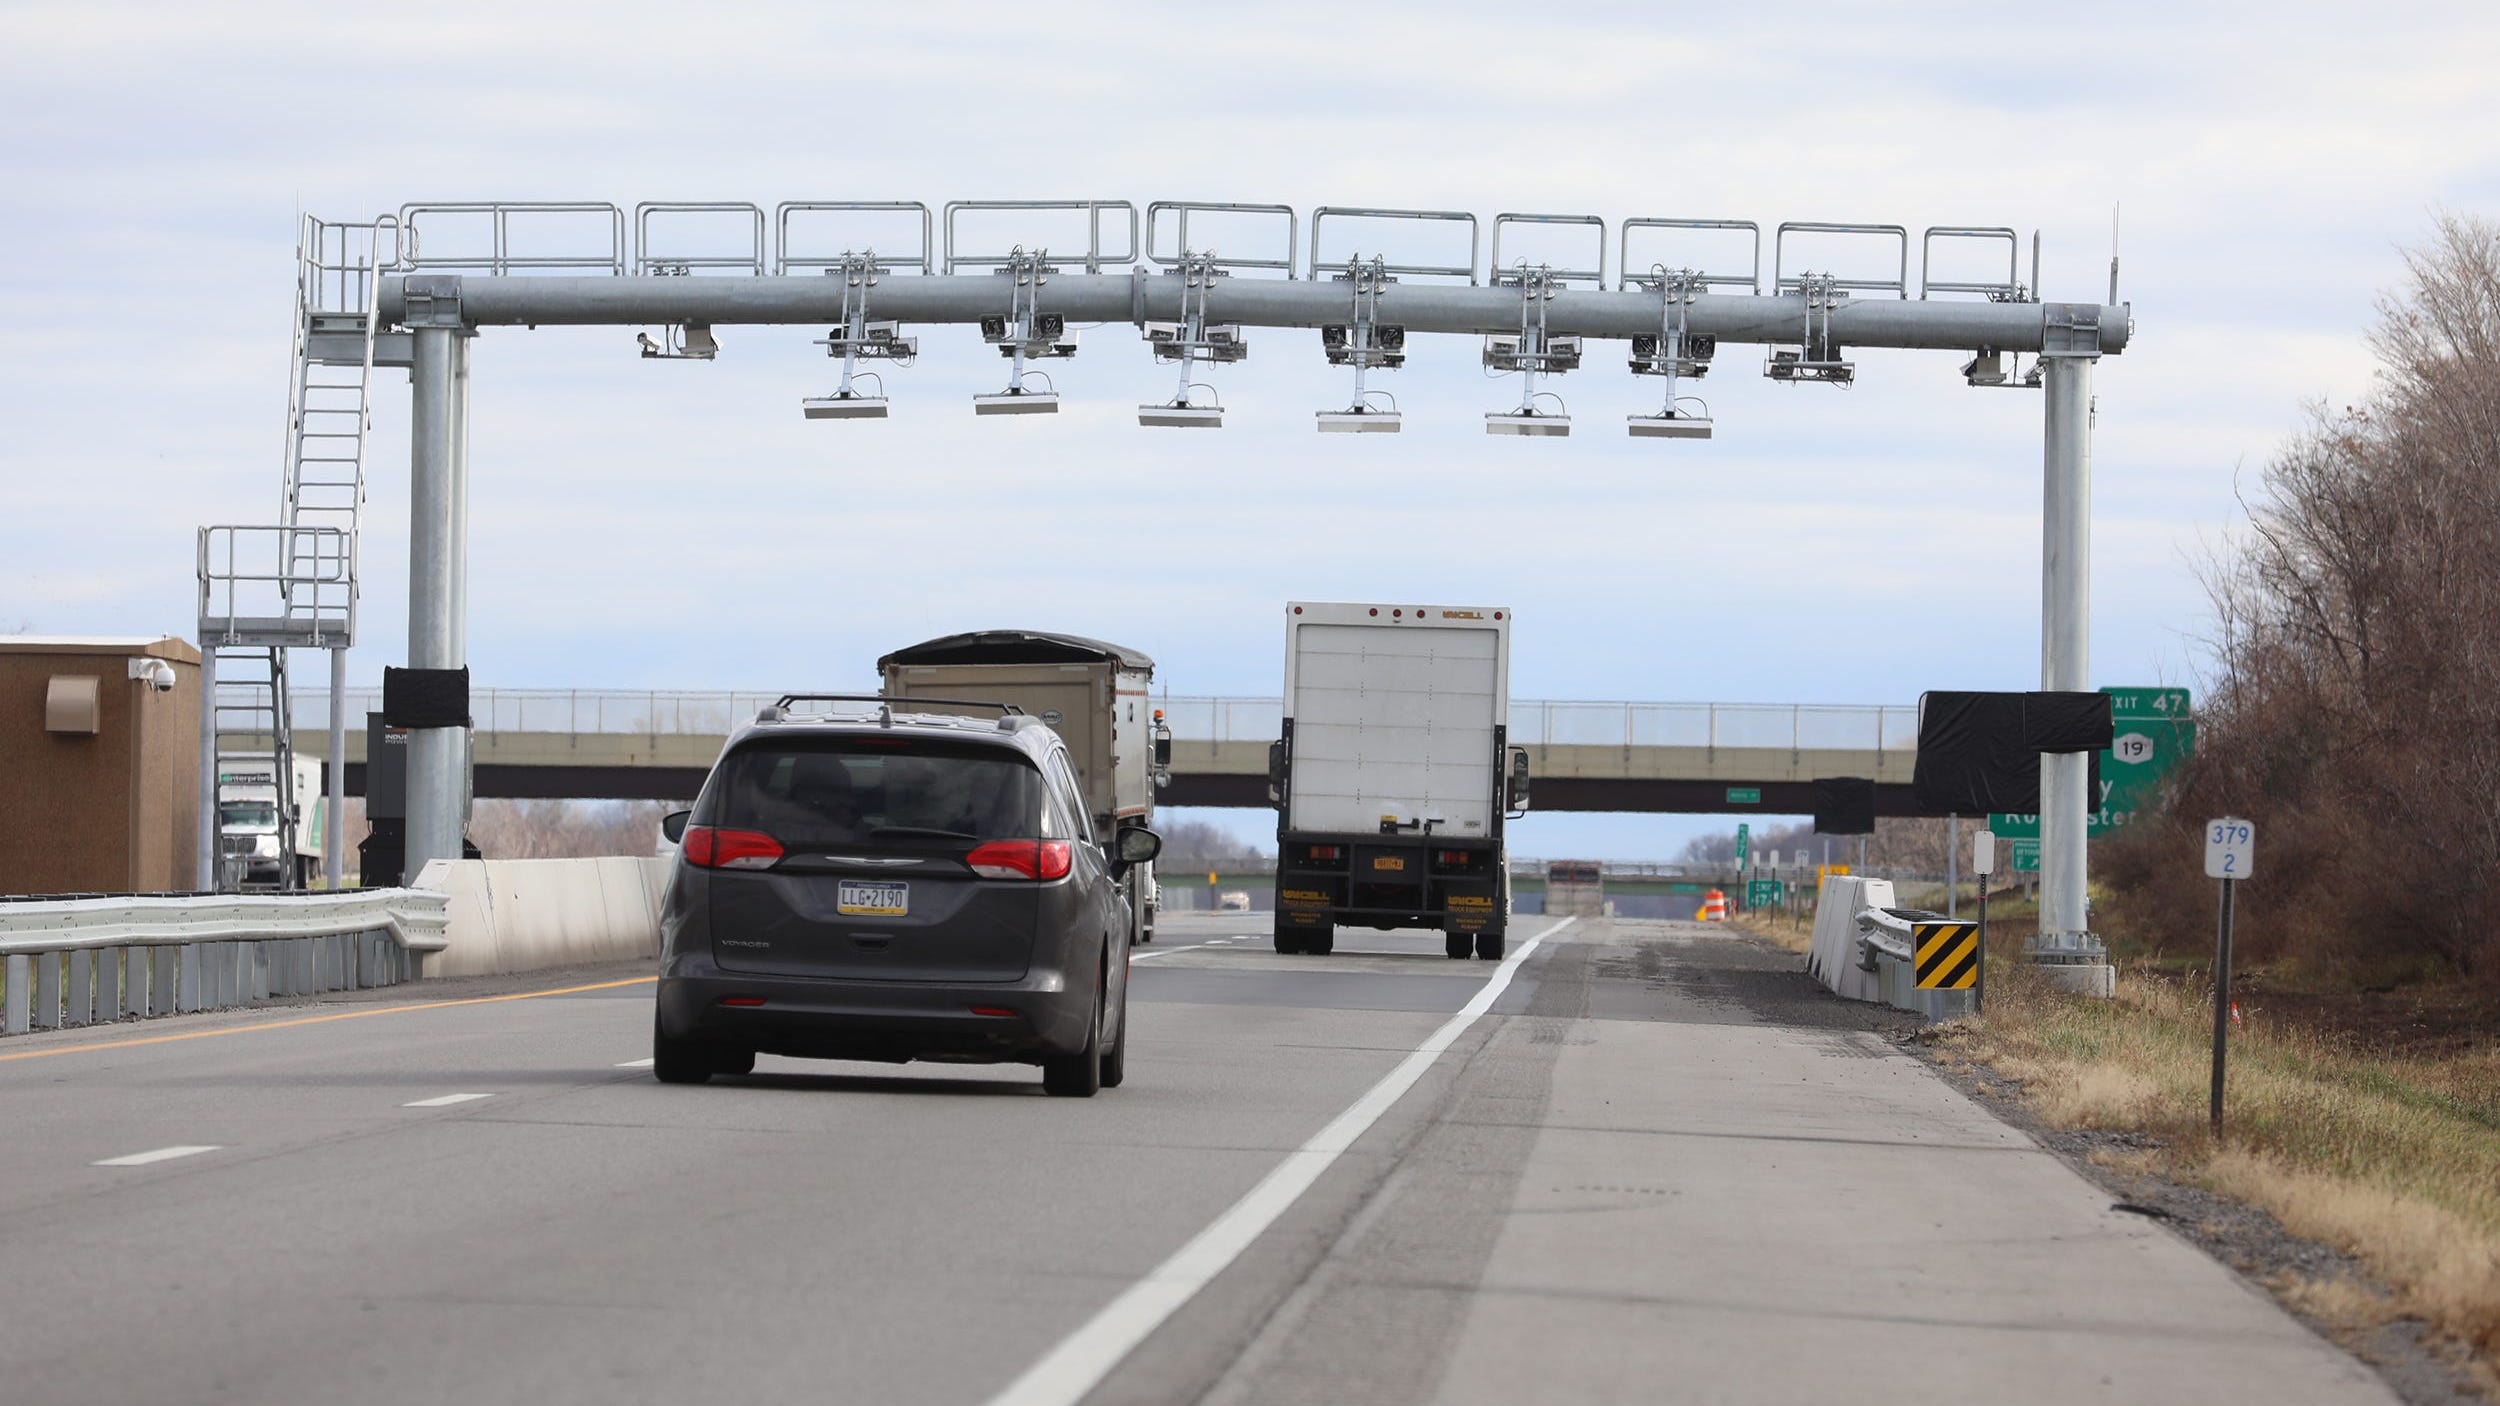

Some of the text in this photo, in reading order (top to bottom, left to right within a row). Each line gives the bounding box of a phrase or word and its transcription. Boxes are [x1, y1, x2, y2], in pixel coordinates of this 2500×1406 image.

[2111, 694, 2183, 711] XIT 47
[2123, 742, 2143, 755] 19
[2212, 825, 2249, 844] 379
[2223, 854, 2235, 872] 2
